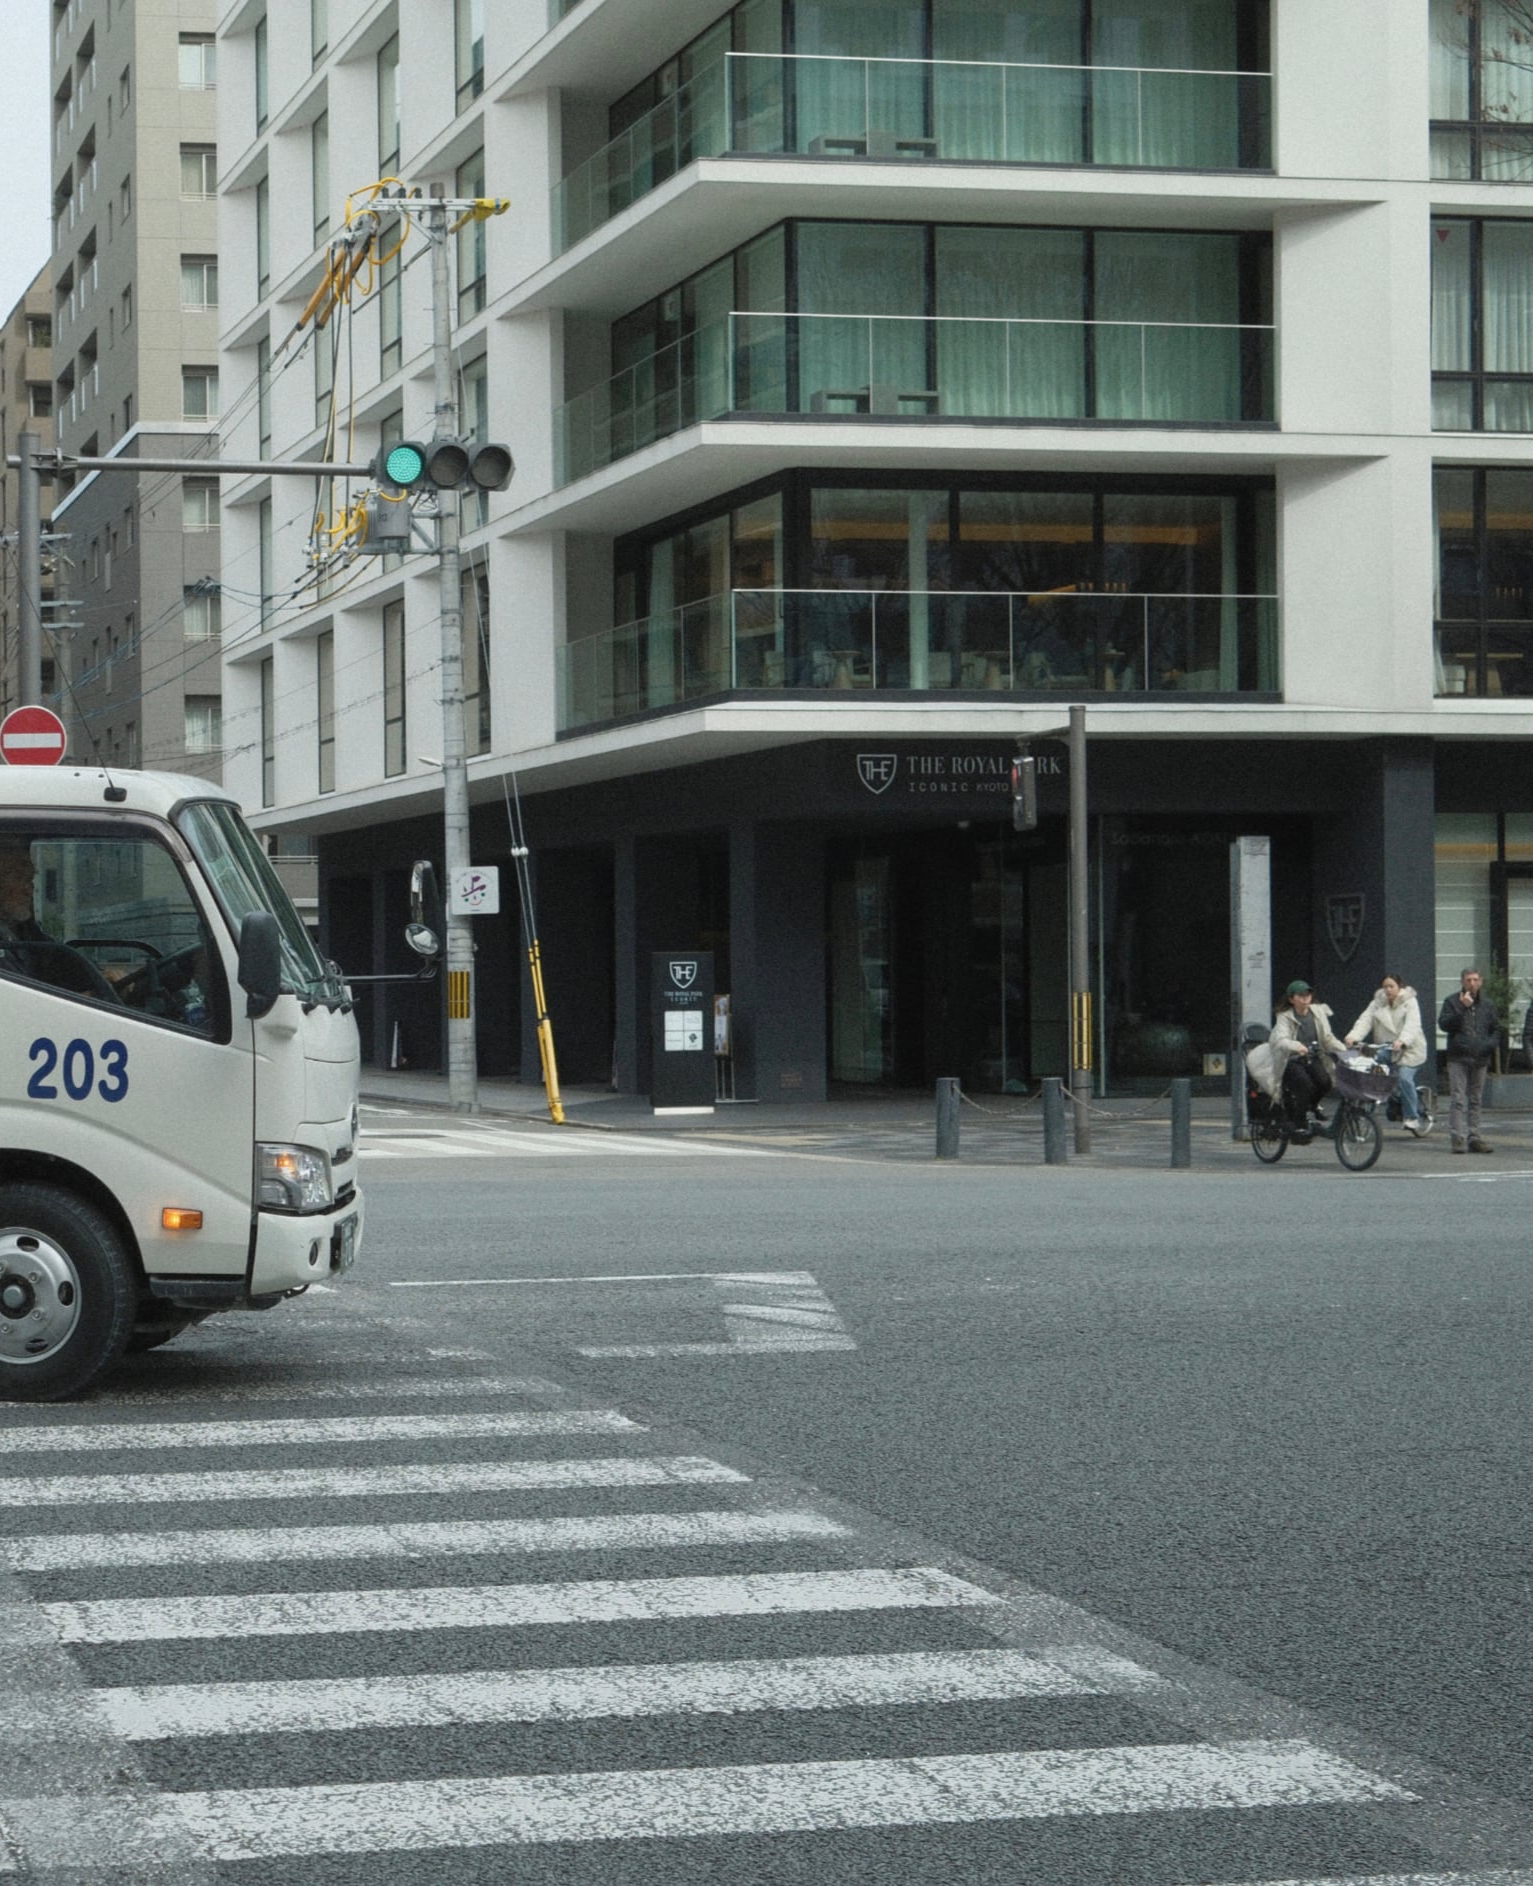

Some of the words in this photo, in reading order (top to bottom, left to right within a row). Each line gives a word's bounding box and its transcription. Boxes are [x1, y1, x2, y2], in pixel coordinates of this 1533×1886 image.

[906, 756, 946, 775] THE
[952, 756, 1009, 775] ROYAL
[908, 782, 968, 792] ICONIC
[976, 782, 1009, 793] KYOTO
[27, 1037, 129, 1103] 203
